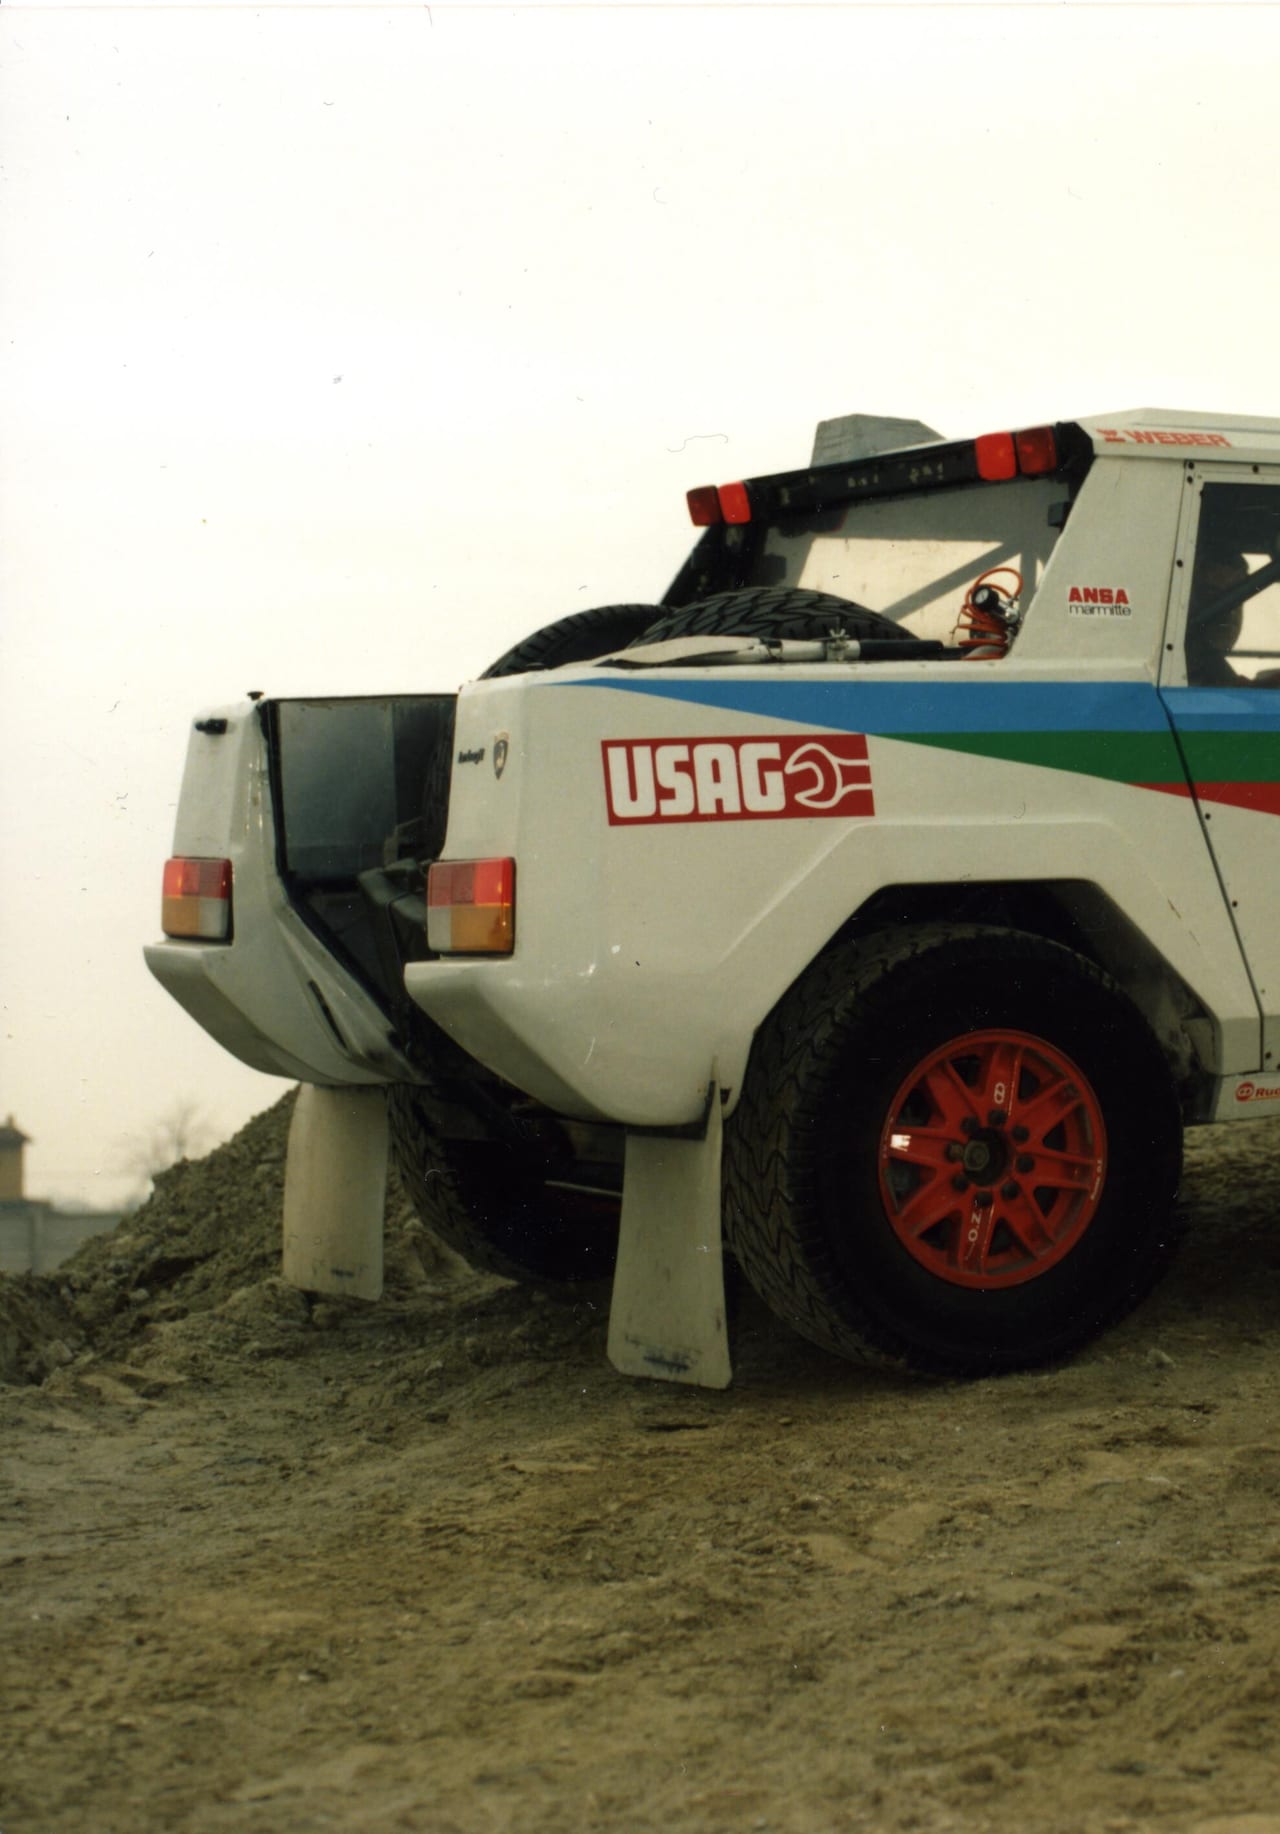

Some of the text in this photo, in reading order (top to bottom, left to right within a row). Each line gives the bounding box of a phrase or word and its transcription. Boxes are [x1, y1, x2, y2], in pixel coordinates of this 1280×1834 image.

[1122, 429, 1232, 448] WEBER
[1068, 586, 1129, 605] ANSA
[1069, 604, 1132, 617] marmitte
[608, 742, 786, 818] USAG
